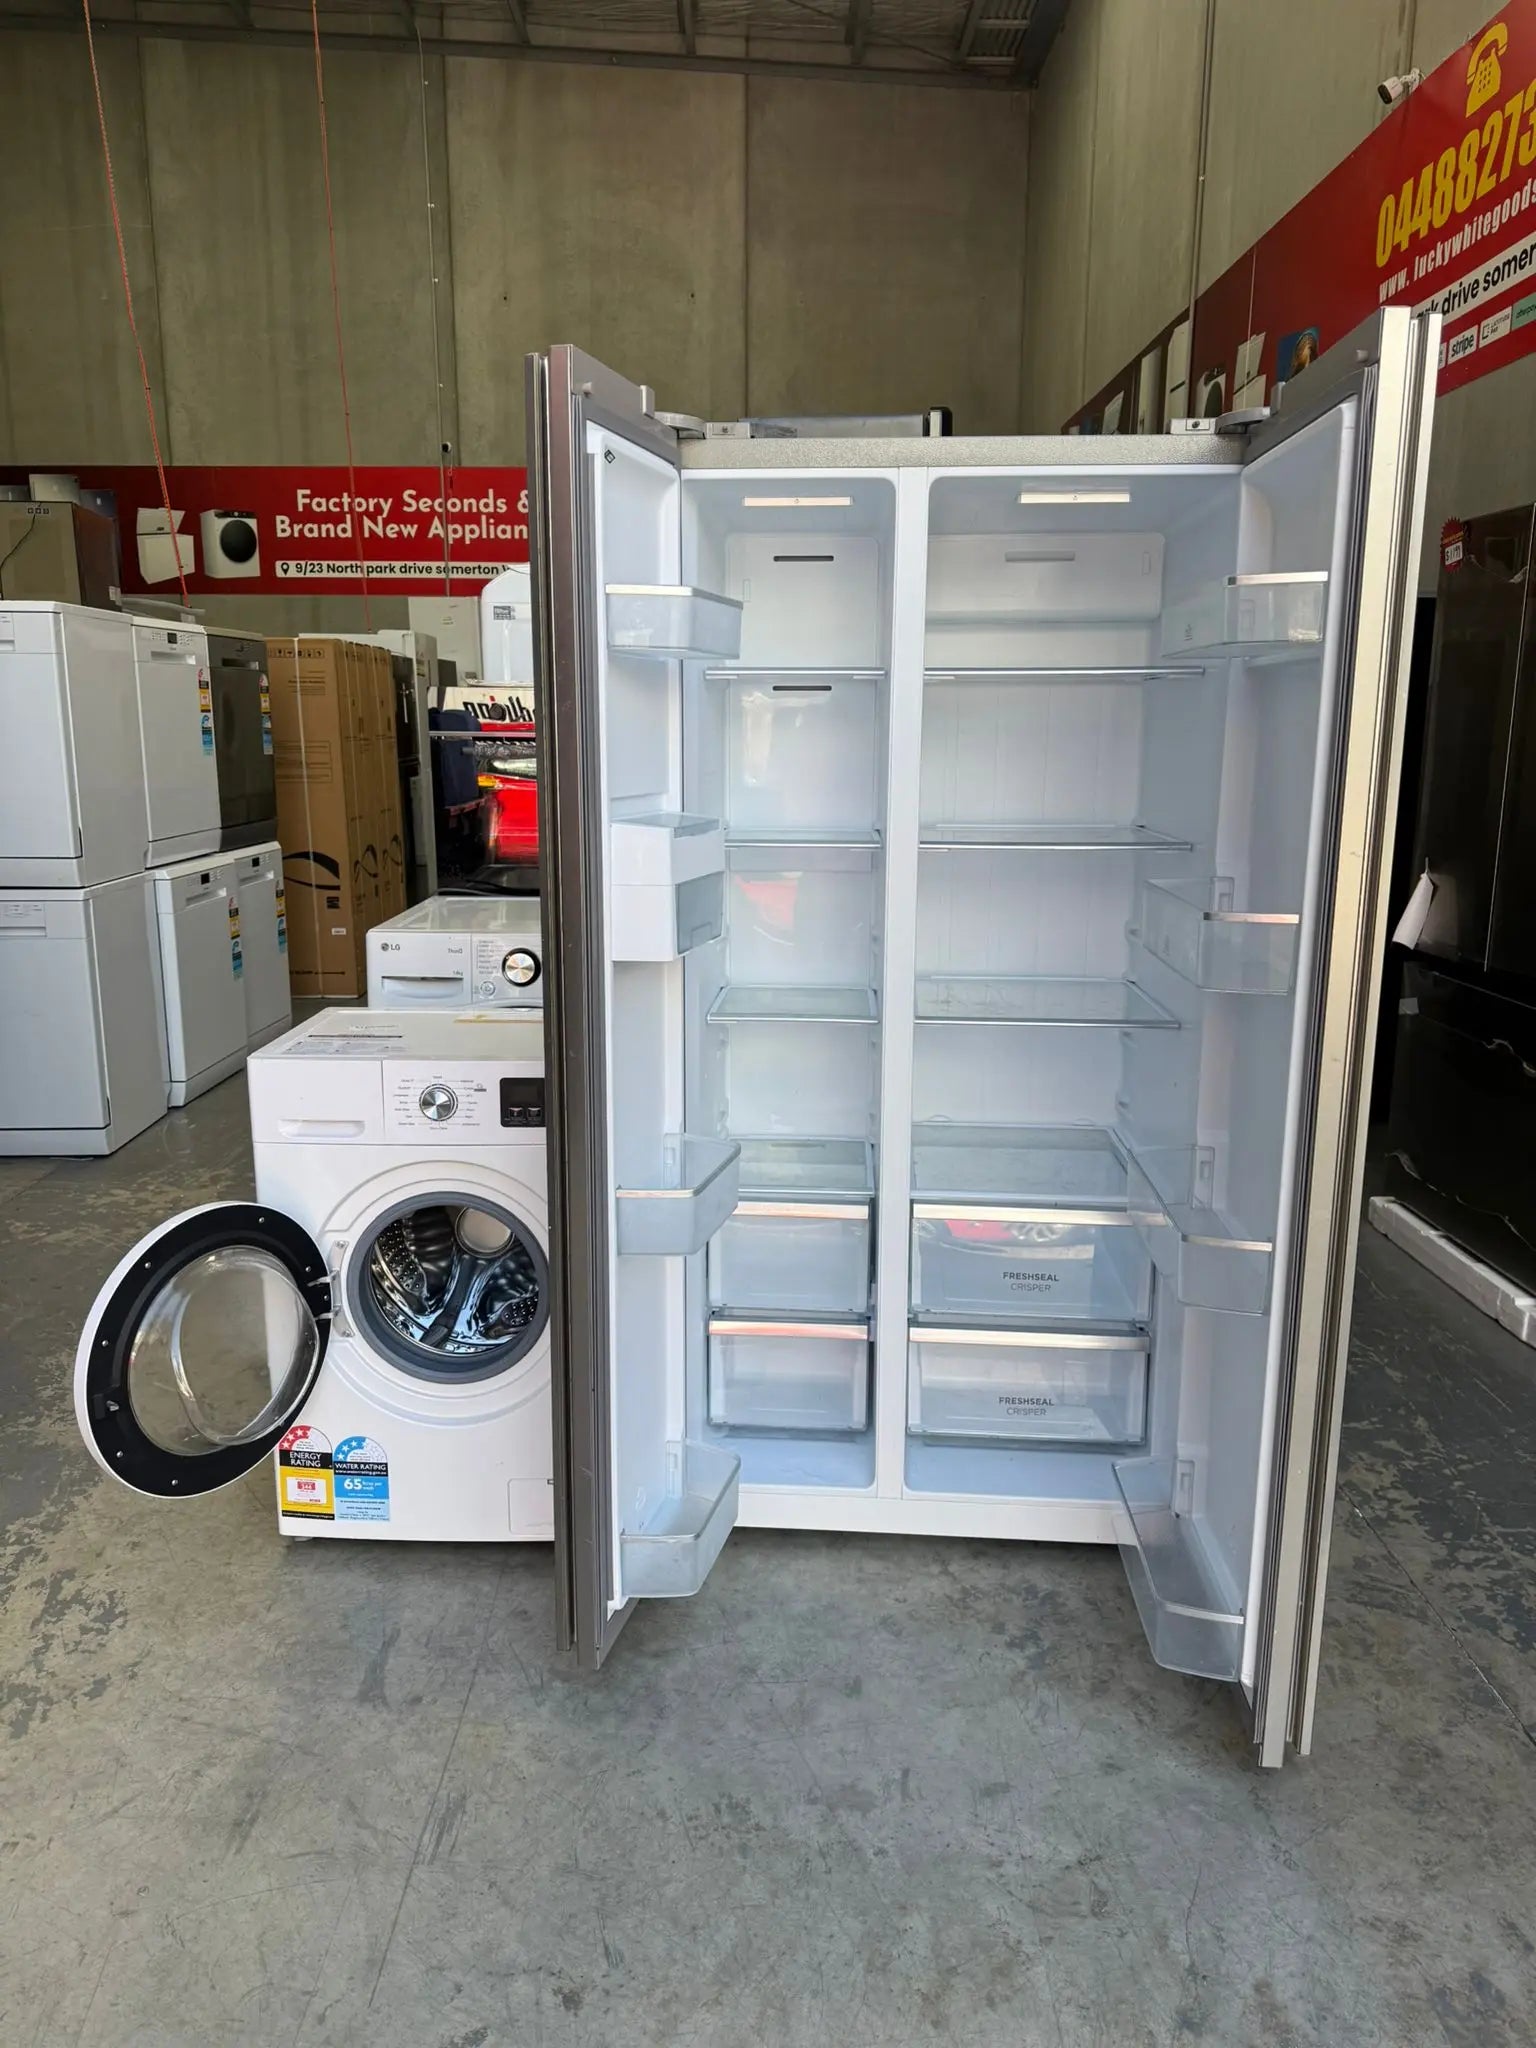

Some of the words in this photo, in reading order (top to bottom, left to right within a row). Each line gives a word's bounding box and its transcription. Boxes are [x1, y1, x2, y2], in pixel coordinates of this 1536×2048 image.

[1376, 78, 1536, 268] 04488273
[1379, 267, 1410, 304] www.
[1441, 278, 1480, 316] drive
[1451, 334, 1475, 358] stripe
[296, 489, 393, 518] Factory
[402, 488, 508, 513] Seconds
[275, 514, 352, 538] Brand
[363, 515, 418, 538] New
[427, 514, 528, 544] Applian
[295, 562, 324, 576] 9/23
[327, 563, 363, 574] North
[366, 563, 396, 577] park
[399, 563, 433, 575] drive
[436, 564, 499, 575] somerton
[1002, 1271, 1060, 1282] FRESHSEAL
[1010, 1282, 1052, 1292] CRISPER
[998, 1396, 1055, 1407] FRESHSEAL
[1006, 1406, 1047, 1416] CRISPER
[290, 1452, 321, 1460] ENERGY
[290, 1459, 321, 1468] RATING
[360, 1463, 386, 1471] RATING
[343, 1478, 362, 1490] 65
